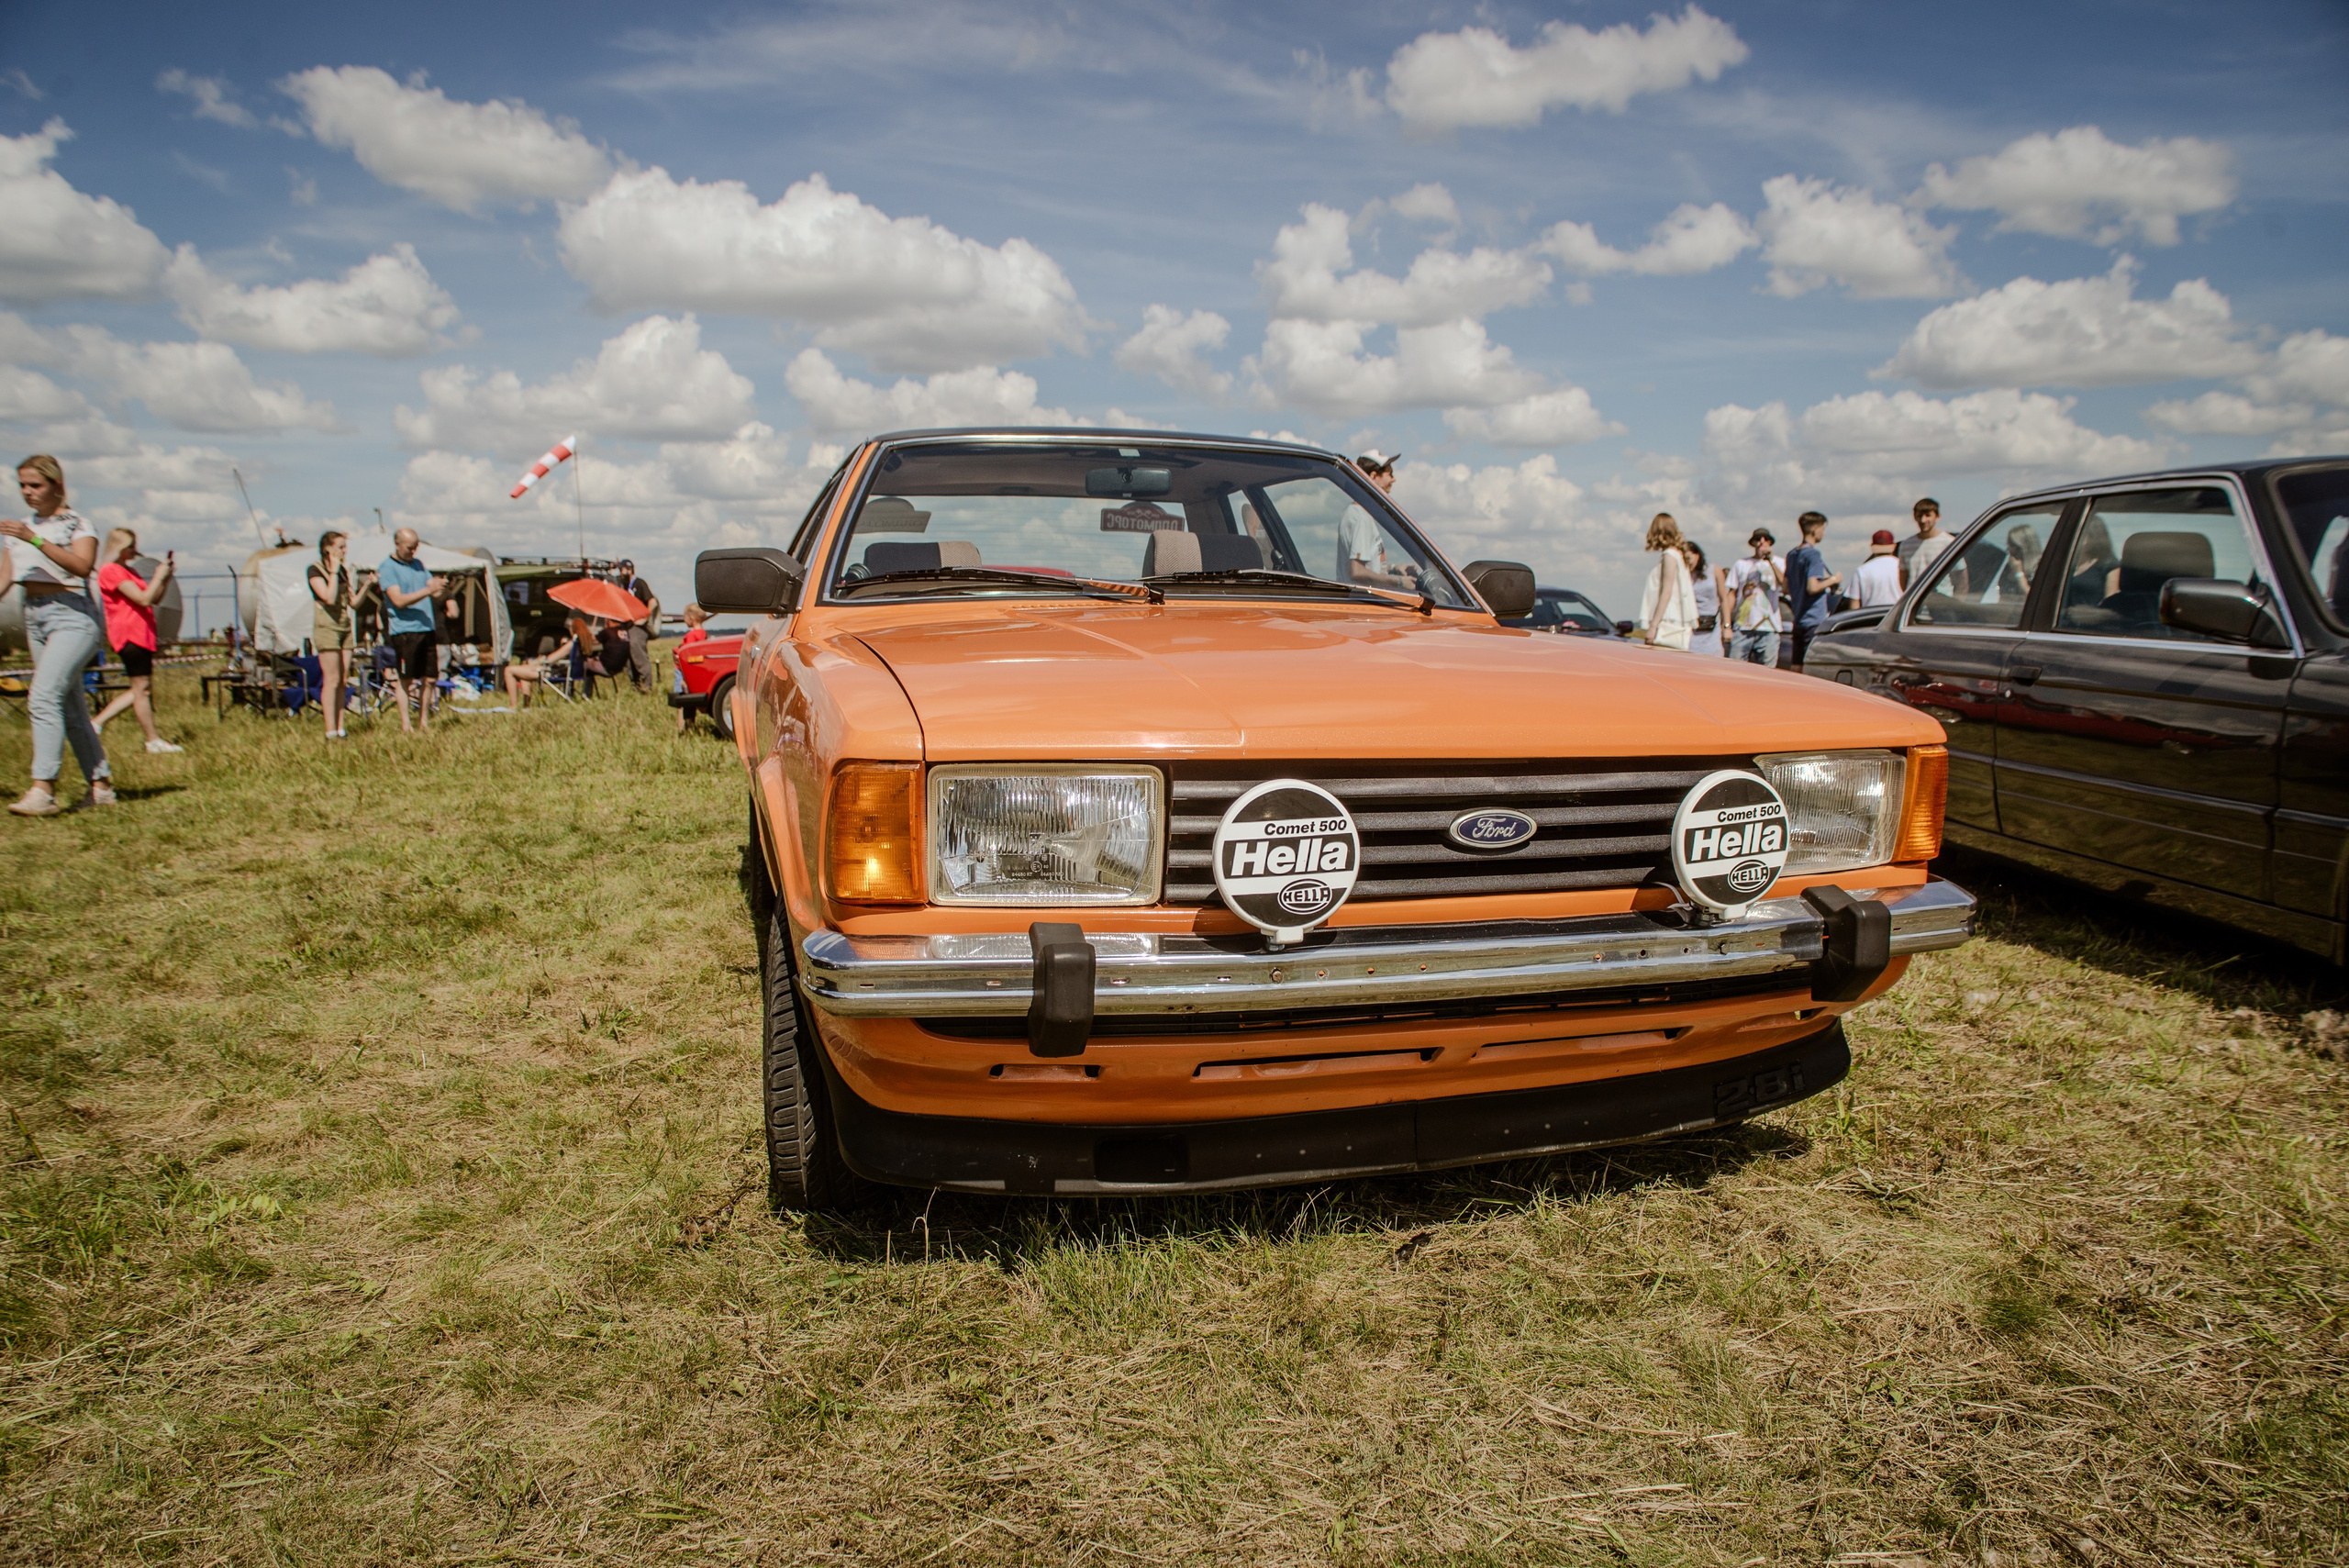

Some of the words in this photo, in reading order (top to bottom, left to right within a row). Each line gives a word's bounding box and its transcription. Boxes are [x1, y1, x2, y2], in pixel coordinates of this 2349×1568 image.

[1718, 807, 1757, 822] Comet
[1760, 804, 1781, 817] 500
[1264, 821, 1315, 835] Comet
[1319, 819, 1347, 831] 500
[1472, 817, 1518, 839] Ford
[1690, 822, 1783, 862] Hella
[1230, 838, 1349, 876] Hella
[1731, 867, 1769, 882] HELLA
[1283, 886, 1330, 902] HELLA
